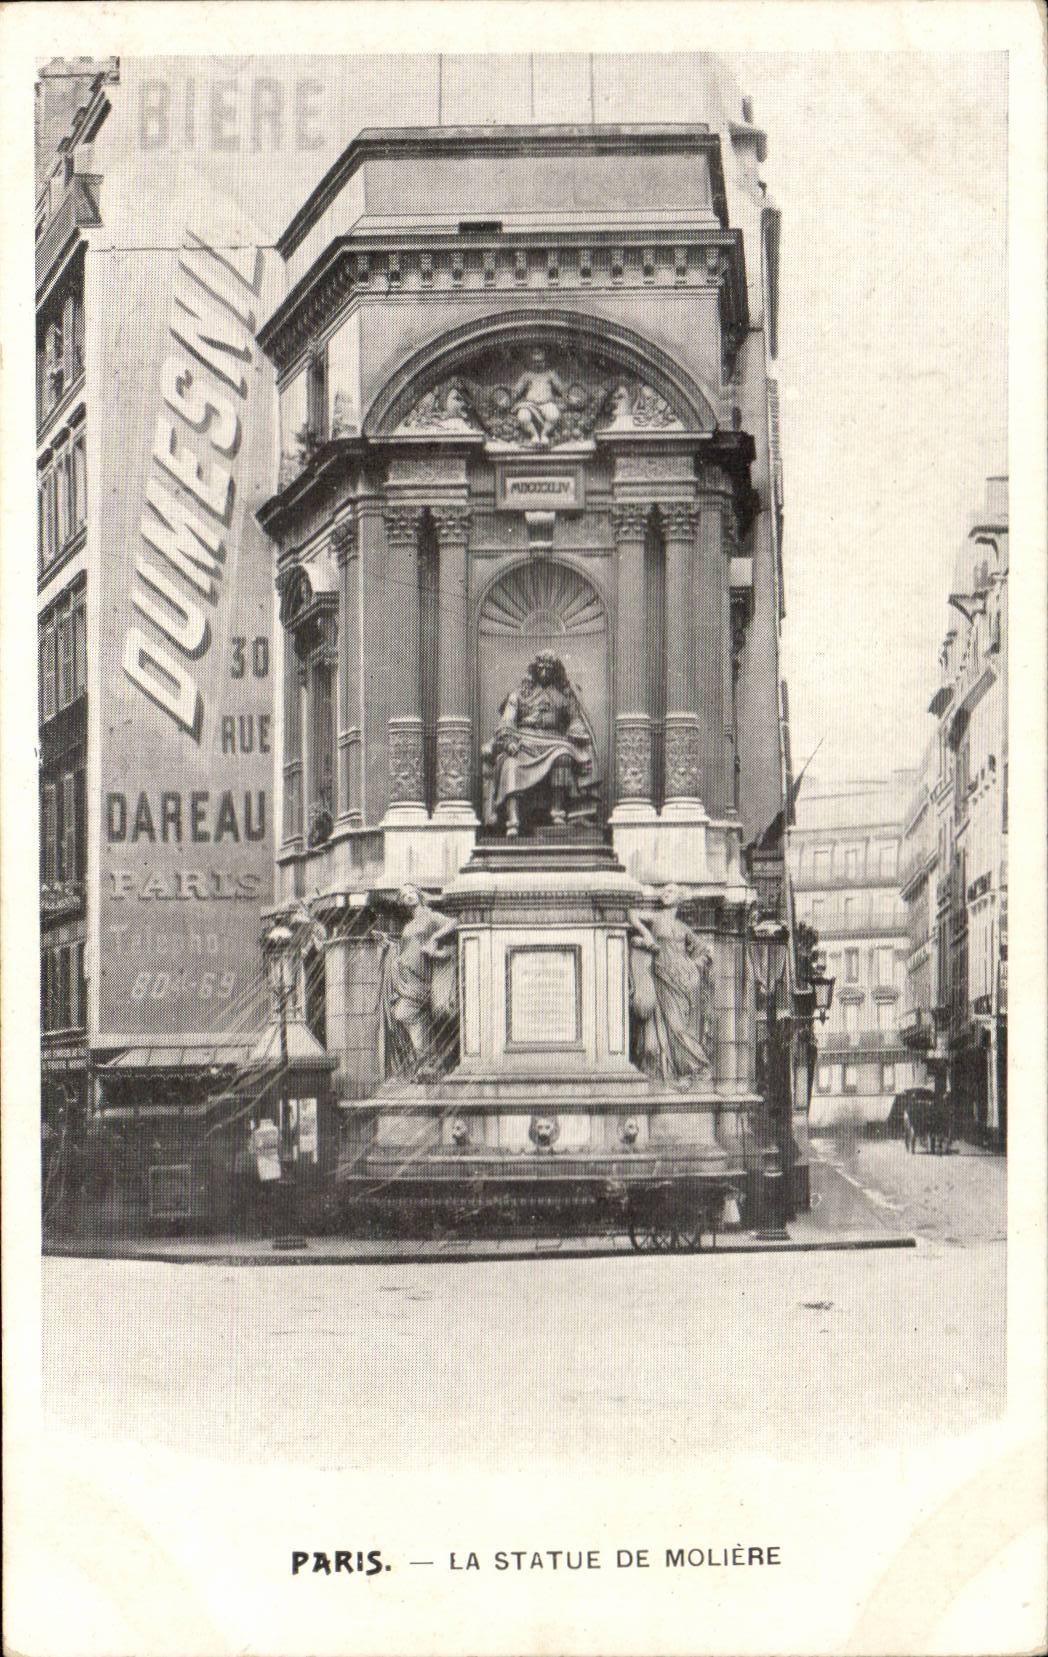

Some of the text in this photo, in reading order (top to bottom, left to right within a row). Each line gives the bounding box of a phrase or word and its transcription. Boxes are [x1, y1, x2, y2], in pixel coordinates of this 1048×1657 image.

[122, 227, 266, 744] DUMESNIL
[231, 637, 269, 680] 30
[222, 714, 271, 753] RUE
[107, 790, 265, 843] DAREAU
[110, 869, 261, 902] PARIS
